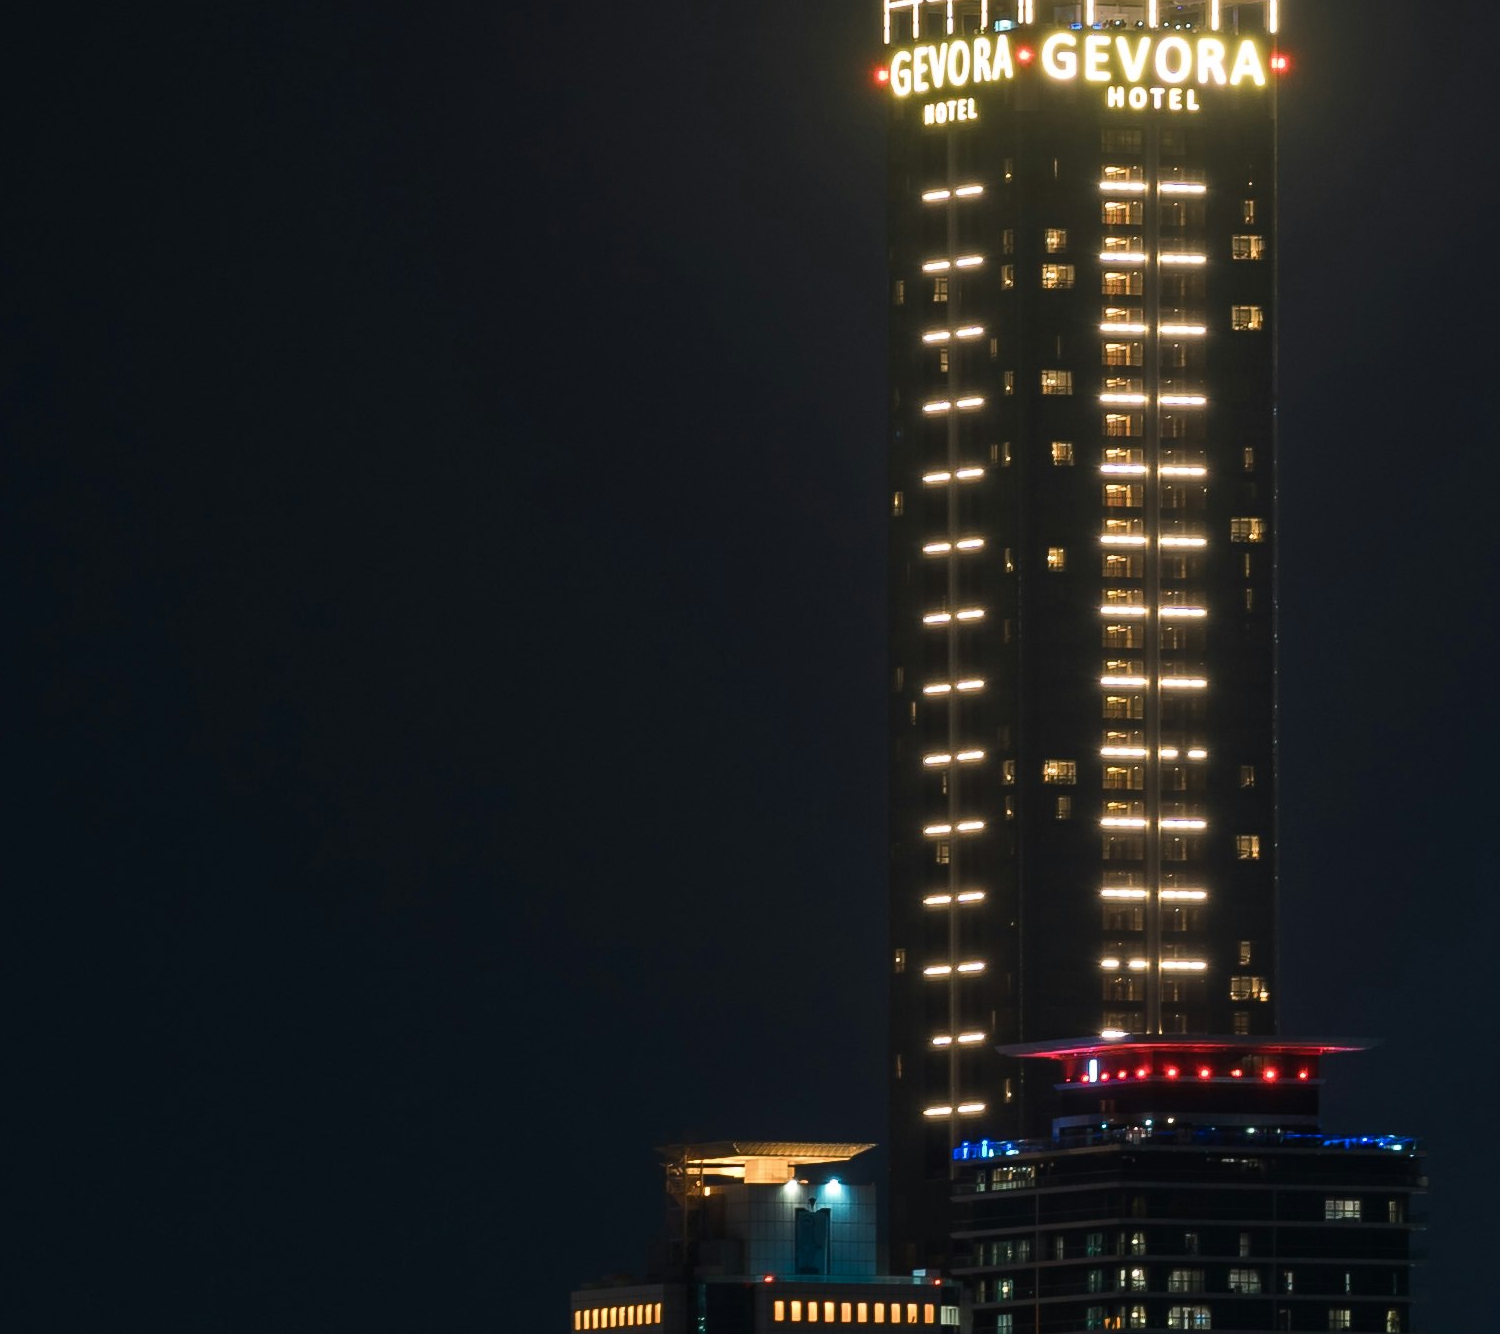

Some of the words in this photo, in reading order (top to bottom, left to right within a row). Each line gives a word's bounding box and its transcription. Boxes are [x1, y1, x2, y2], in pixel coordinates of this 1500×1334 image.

[890, 34, 1014, 97] GEVORA
[1041, 32, 1267, 87] GEVORA
[924, 97, 978, 126] HOTEL
[1107, 85, 1200, 111] HOTEL
